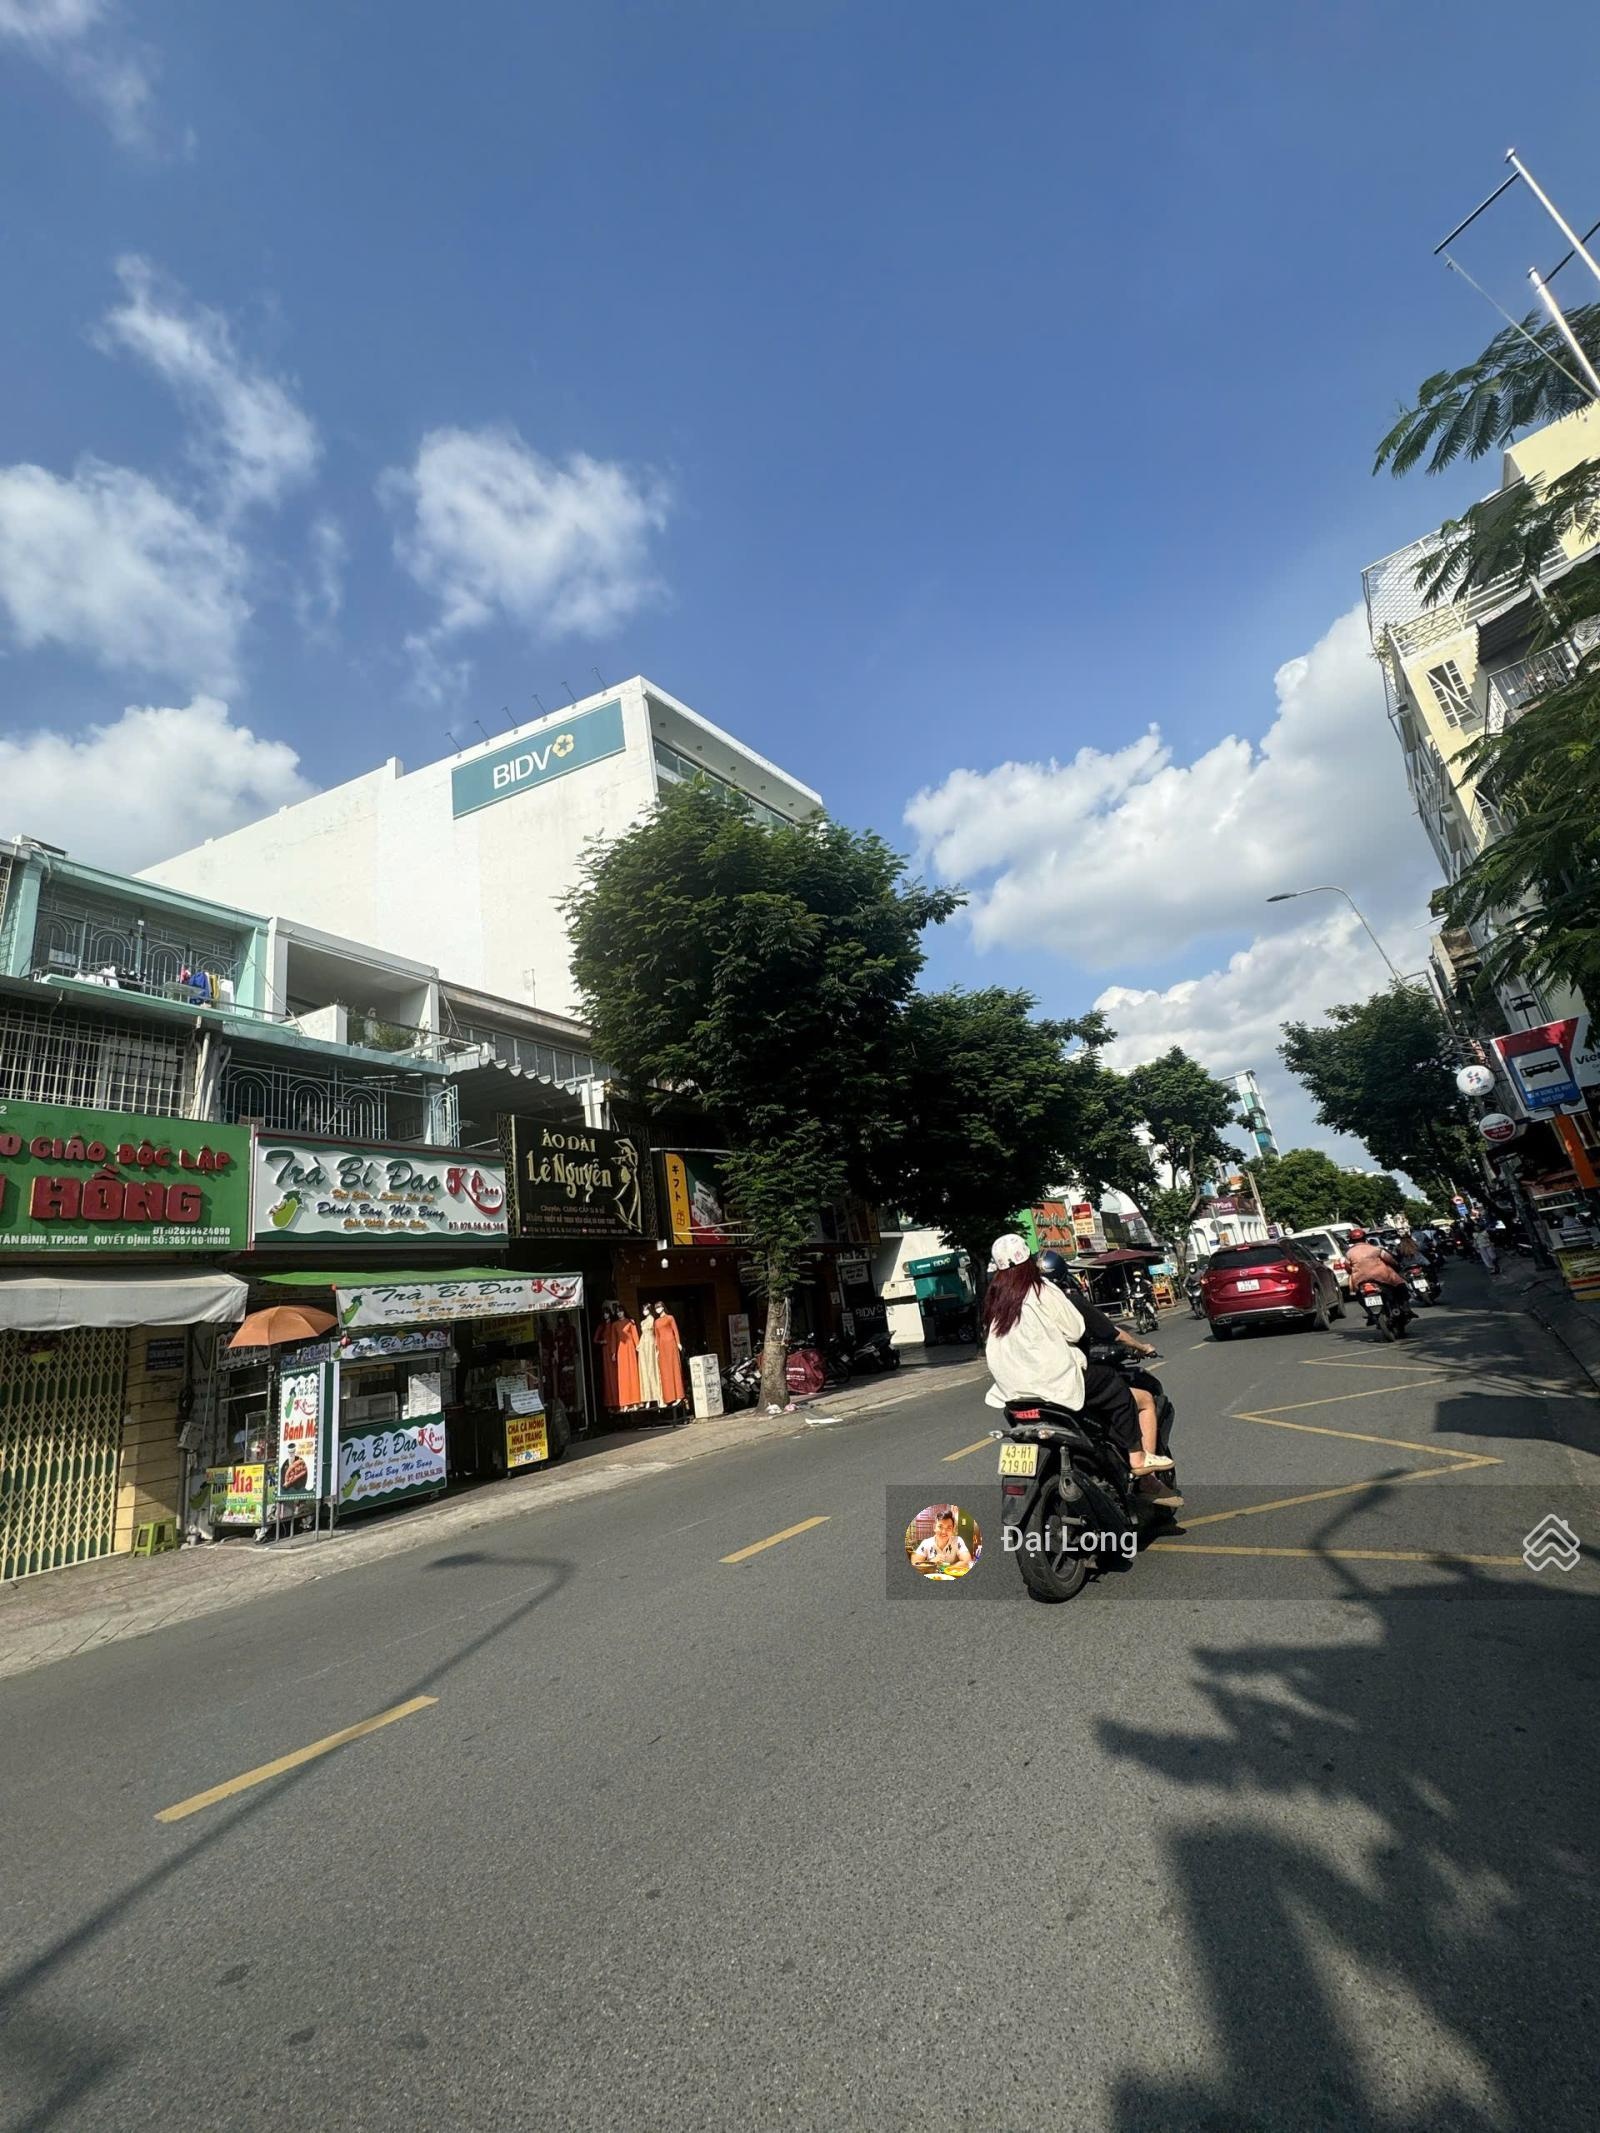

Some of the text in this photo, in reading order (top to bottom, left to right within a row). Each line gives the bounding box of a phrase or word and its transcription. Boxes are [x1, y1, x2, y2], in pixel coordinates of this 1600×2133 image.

[493, 744, 553, 789] BIDV
[30, 1133, 106, 1162] GIÁO
[116, 1140, 173, 1171] ĐỘC
[179, 1144, 231, 1175] LẬP
[567, 1134, 596, 1153] DÀI
[264, 1149, 326, 1186] Trà
[337, 1156, 374, 1188] Bí
[526, 1150, 613, 1202] Lê Nguyễn
[30, 1163, 202, 1222] HỒNG
[372, 1287, 424, 1303] Trà
[438, 1284, 467, 1298] Bí
[282, 1421, 304, 1442] Bánh
[341, 1442, 367, 1466] Trà
[372, 1436, 389, 1459] Bí
[1005, 1445, 1032, 1459] 43-H1
